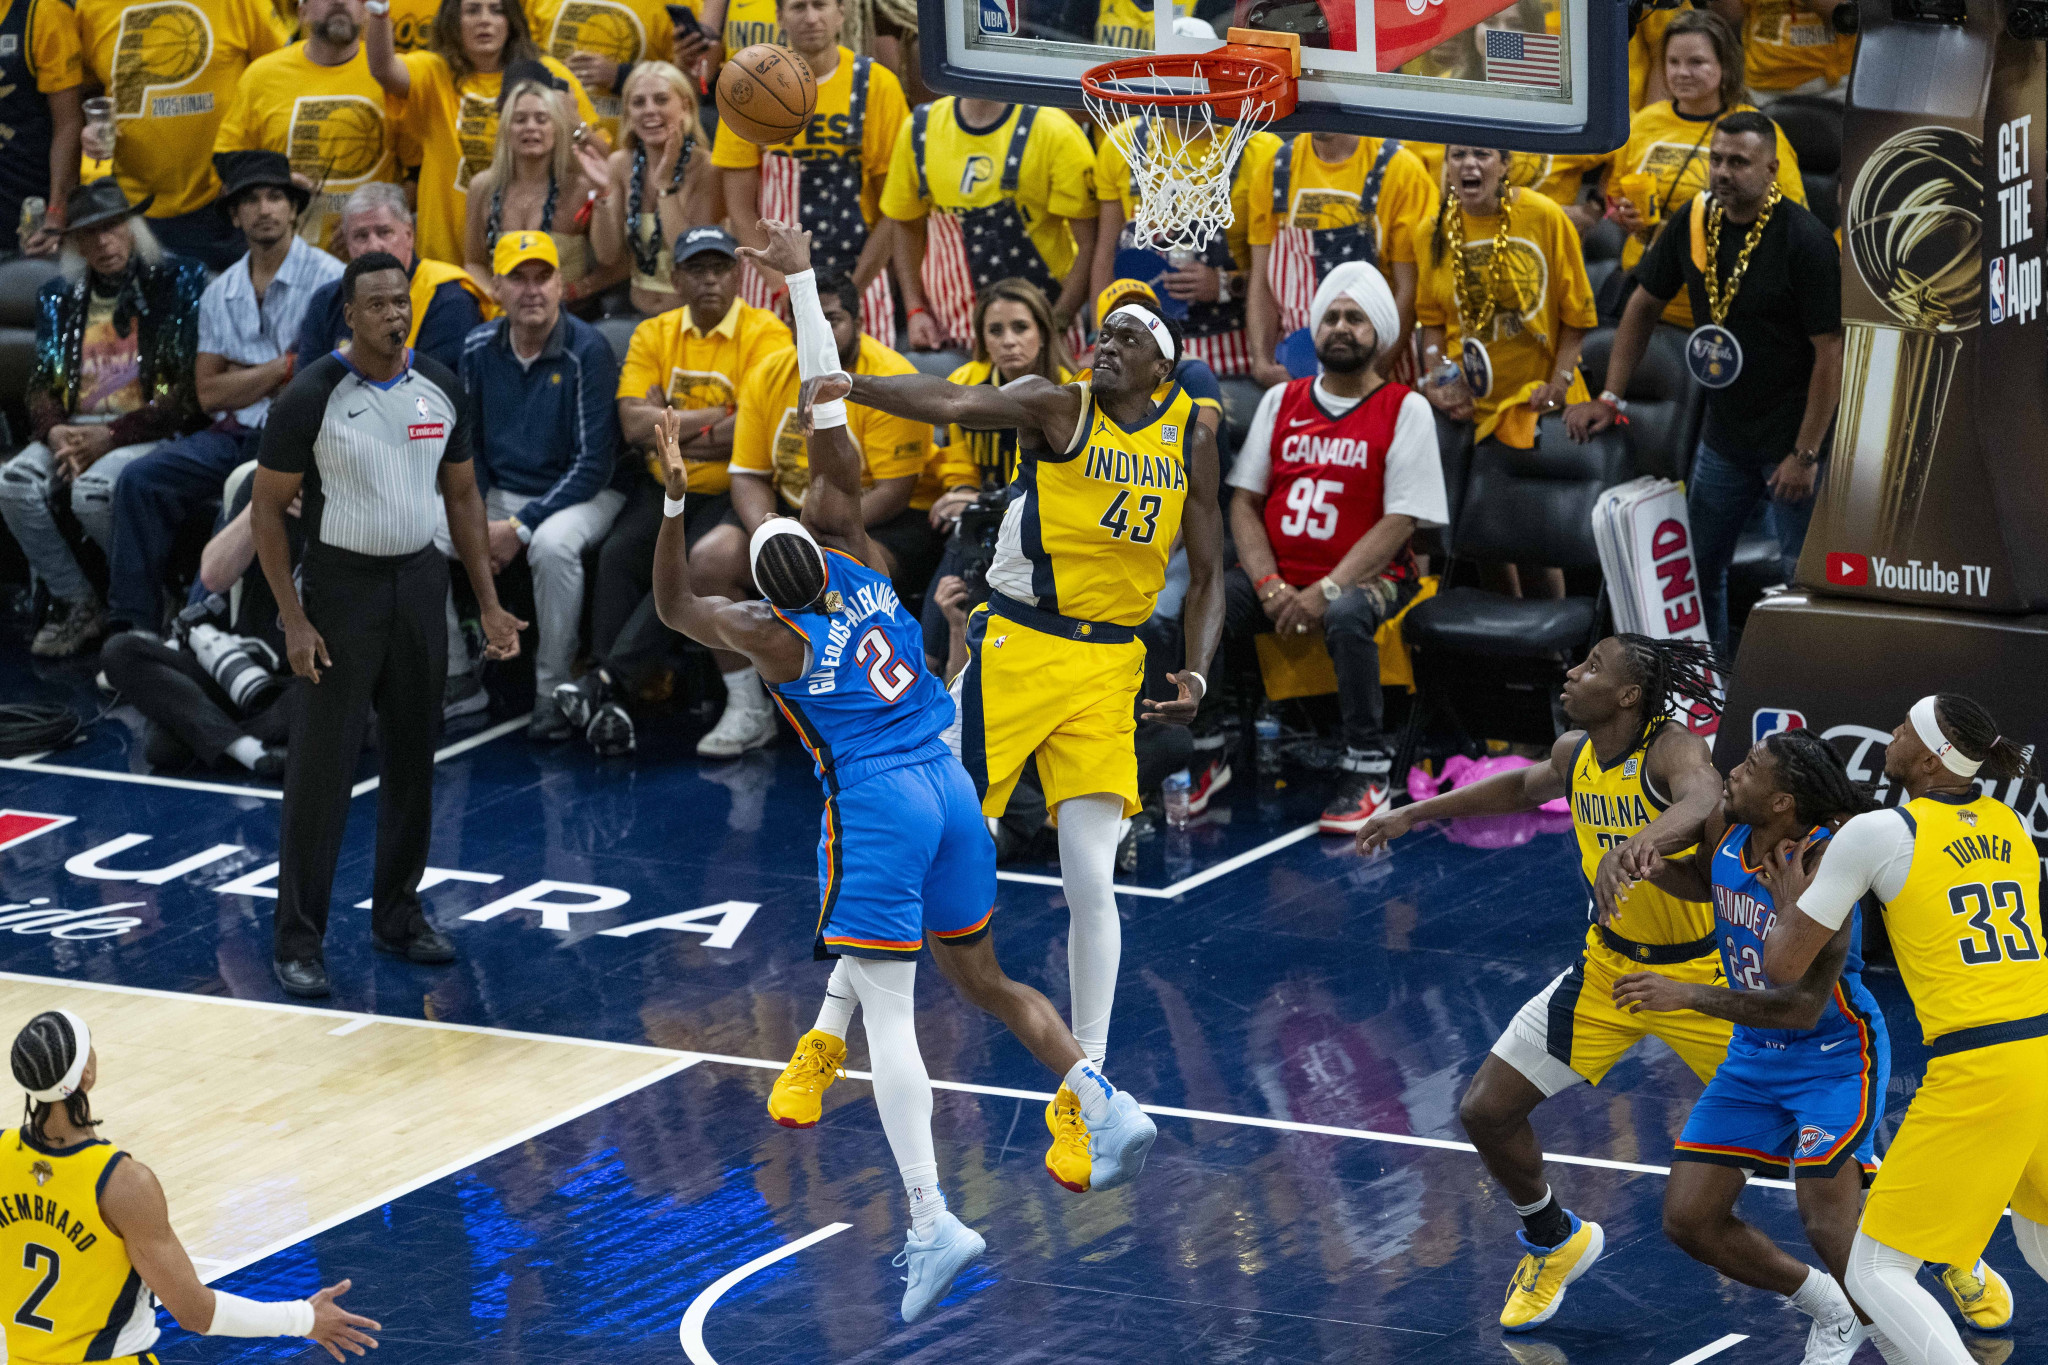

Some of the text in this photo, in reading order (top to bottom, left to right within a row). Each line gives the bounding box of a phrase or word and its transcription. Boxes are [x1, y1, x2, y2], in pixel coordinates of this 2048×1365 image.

[984, 10, 1003, 28] NBA
[1998, 114, 2032, 184] GET
[1998, 179, 2033, 249] THE
[2007, 252, 2042, 325] App
[409, 426, 443, 438] Emirates
[1282, 434, 1368, 470] CANADA
[1083, 445, 1185, 492] INDIANA
[1099, 489, 1162, 544] 43
[1281, 477, 1344, 540] 95
[1871, 556, 1991, 597] YouTube TV
[854, 625, 919, 704] 2
[1574, 791, 1651, 828] INDIANA
[1943, 834, 2012, 868] TURNER
[1947, 880, 2041, 966] 33
[1725, 935, 1767, 991] 22
[14, 1242, 60, 1333] 2
